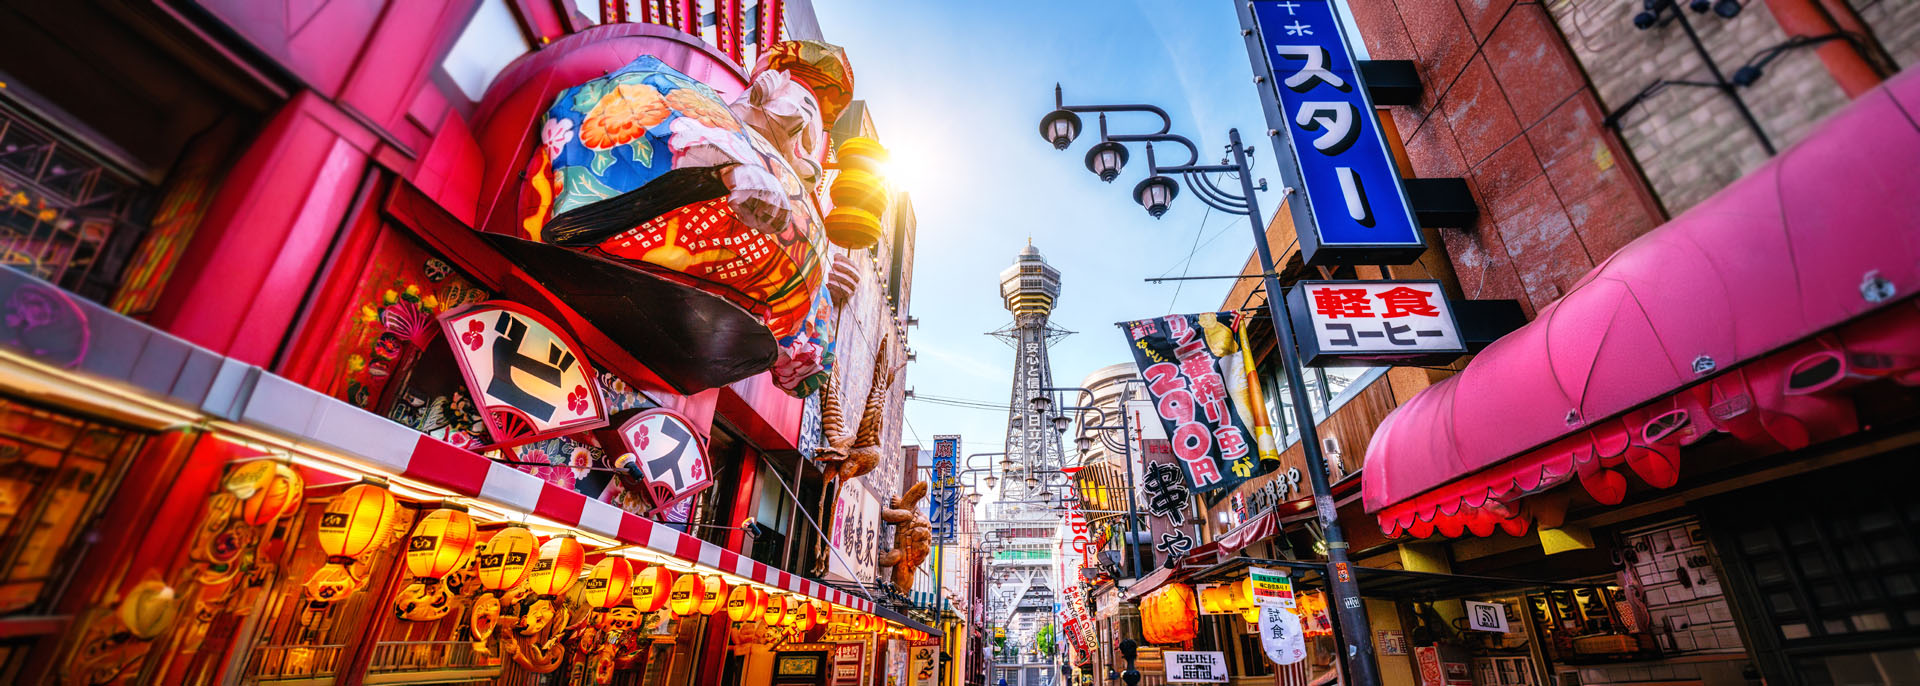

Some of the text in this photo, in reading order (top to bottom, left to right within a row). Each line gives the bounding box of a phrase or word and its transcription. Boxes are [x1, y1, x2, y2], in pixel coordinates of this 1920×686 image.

[1275, 45, 1371, 222] スター
[1312, 286, 1441, 320] 軽食
[1325, 321, 1443, 347] コーヒー
[486, 310, 576, 424] ビ
[647, 415, 692, 491] ス
[1143, 459, 1194, 557] 串や
[1267, 608, 1286, 640] 試食
